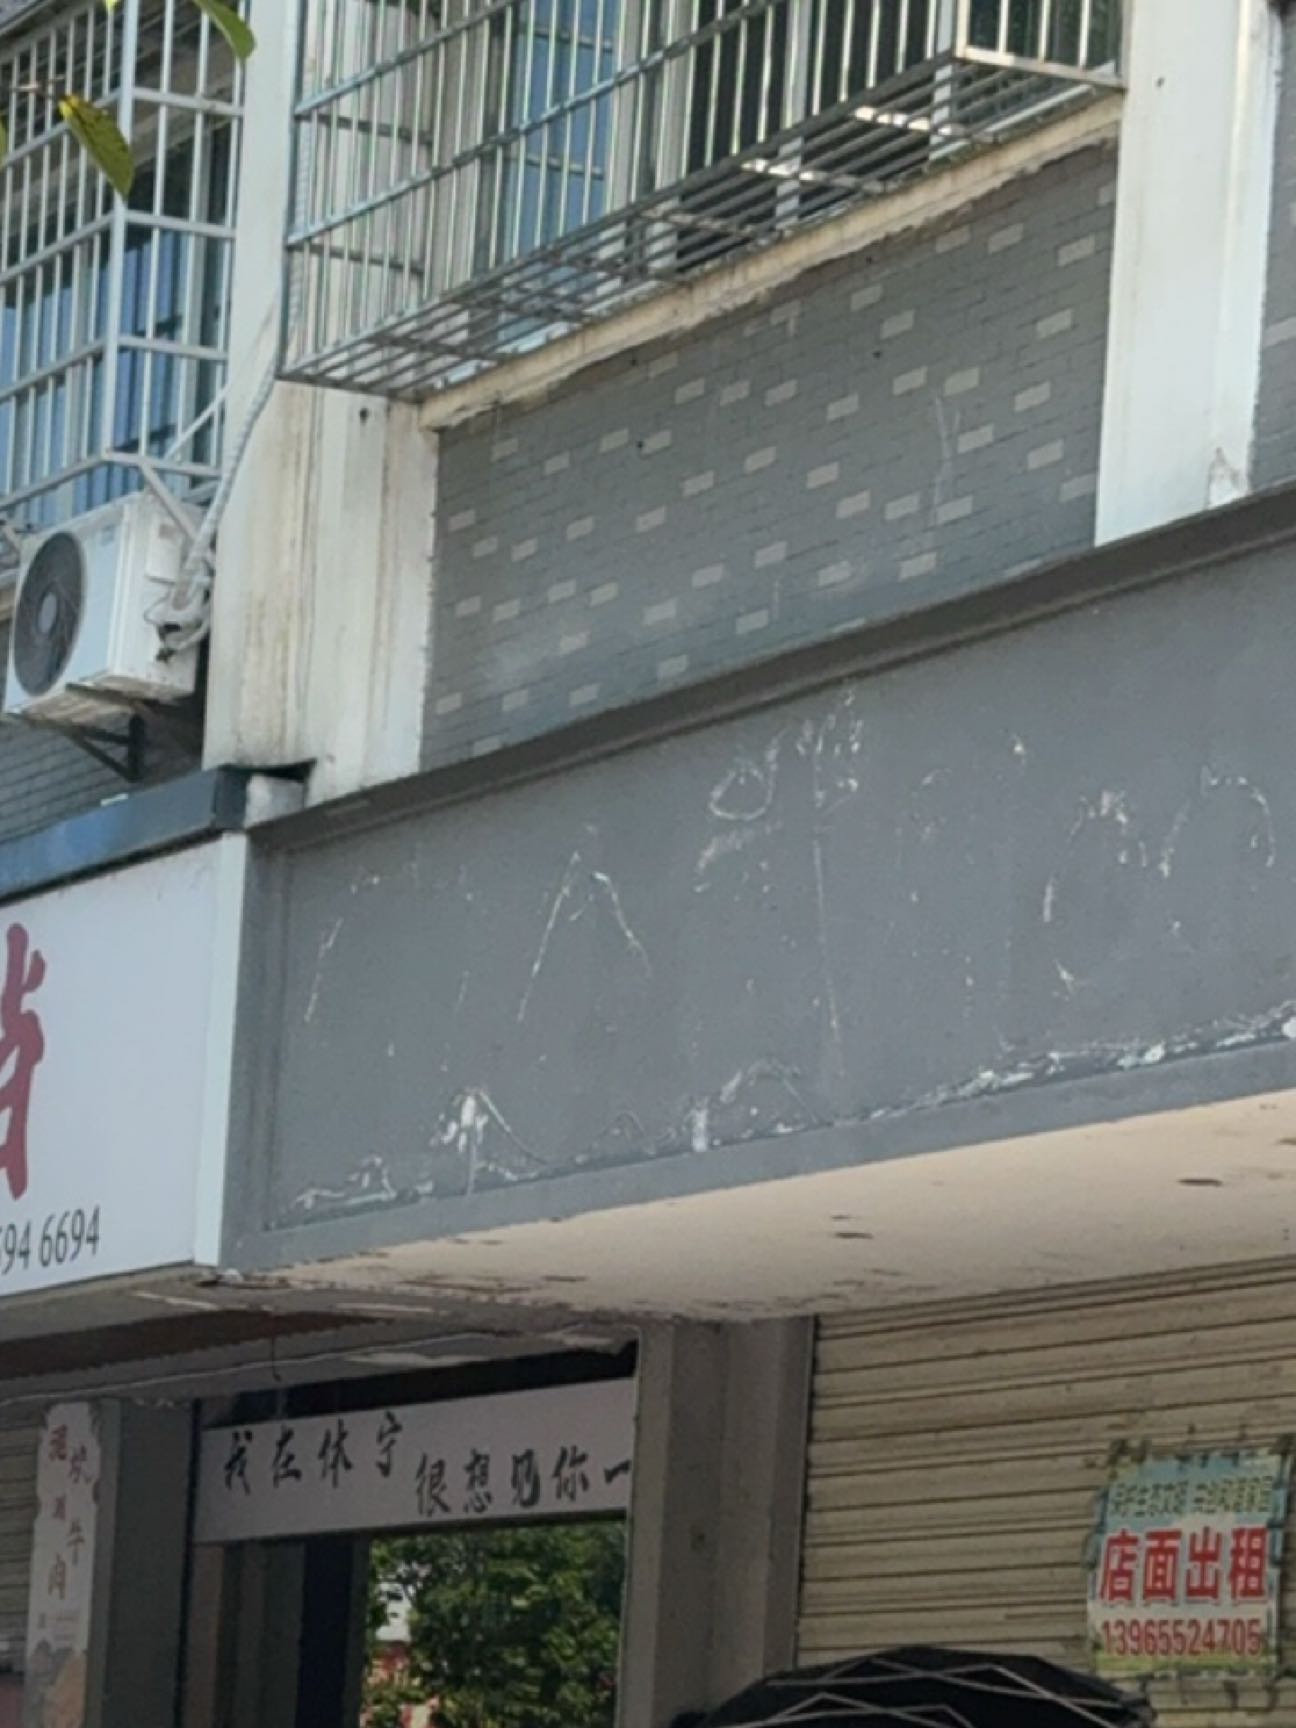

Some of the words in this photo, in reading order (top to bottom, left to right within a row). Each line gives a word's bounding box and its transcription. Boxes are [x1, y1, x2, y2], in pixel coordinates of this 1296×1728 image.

[1099, 1525, 1270, 1603] 店面出租
[1100, 1617, 1263, 1658] 13965524705
